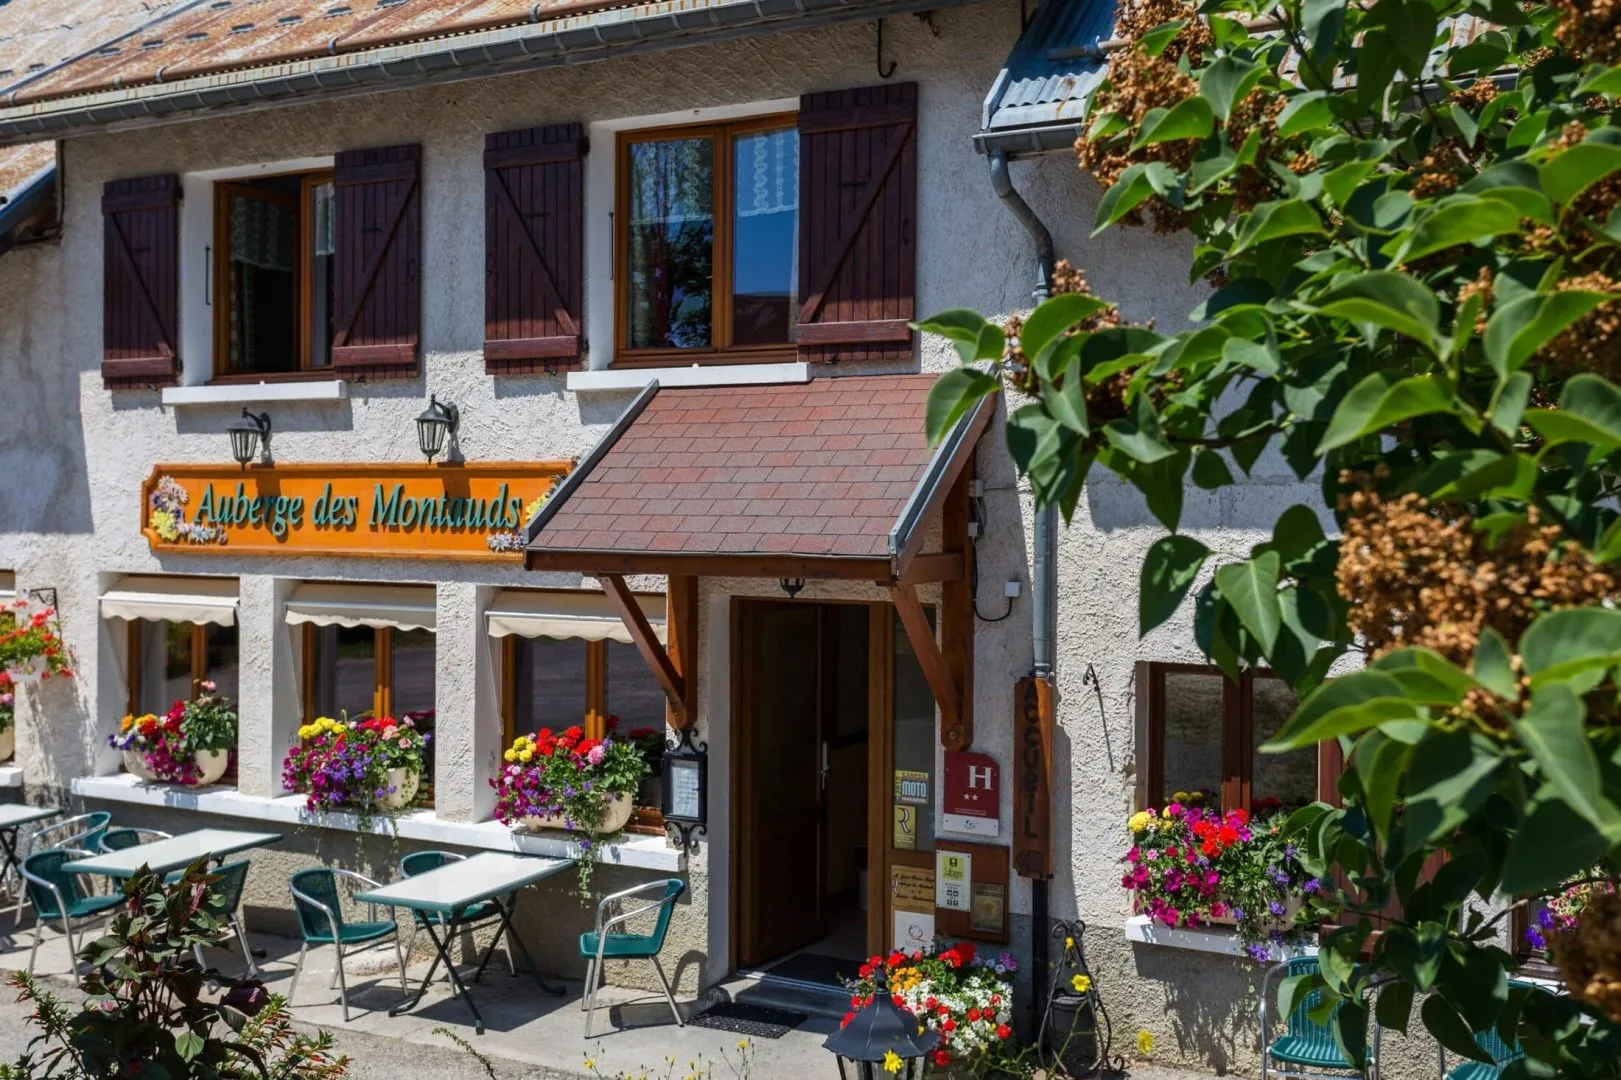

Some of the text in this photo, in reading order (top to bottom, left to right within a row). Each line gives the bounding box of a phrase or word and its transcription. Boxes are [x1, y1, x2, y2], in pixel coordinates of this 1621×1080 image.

[196, 482, 522, 537] Auberge des Montauds
[968, 765, 993, 790] H
[1023, 679, 1040, 840] ACCUEIL
[902, 781, 926, 797] MOTO
